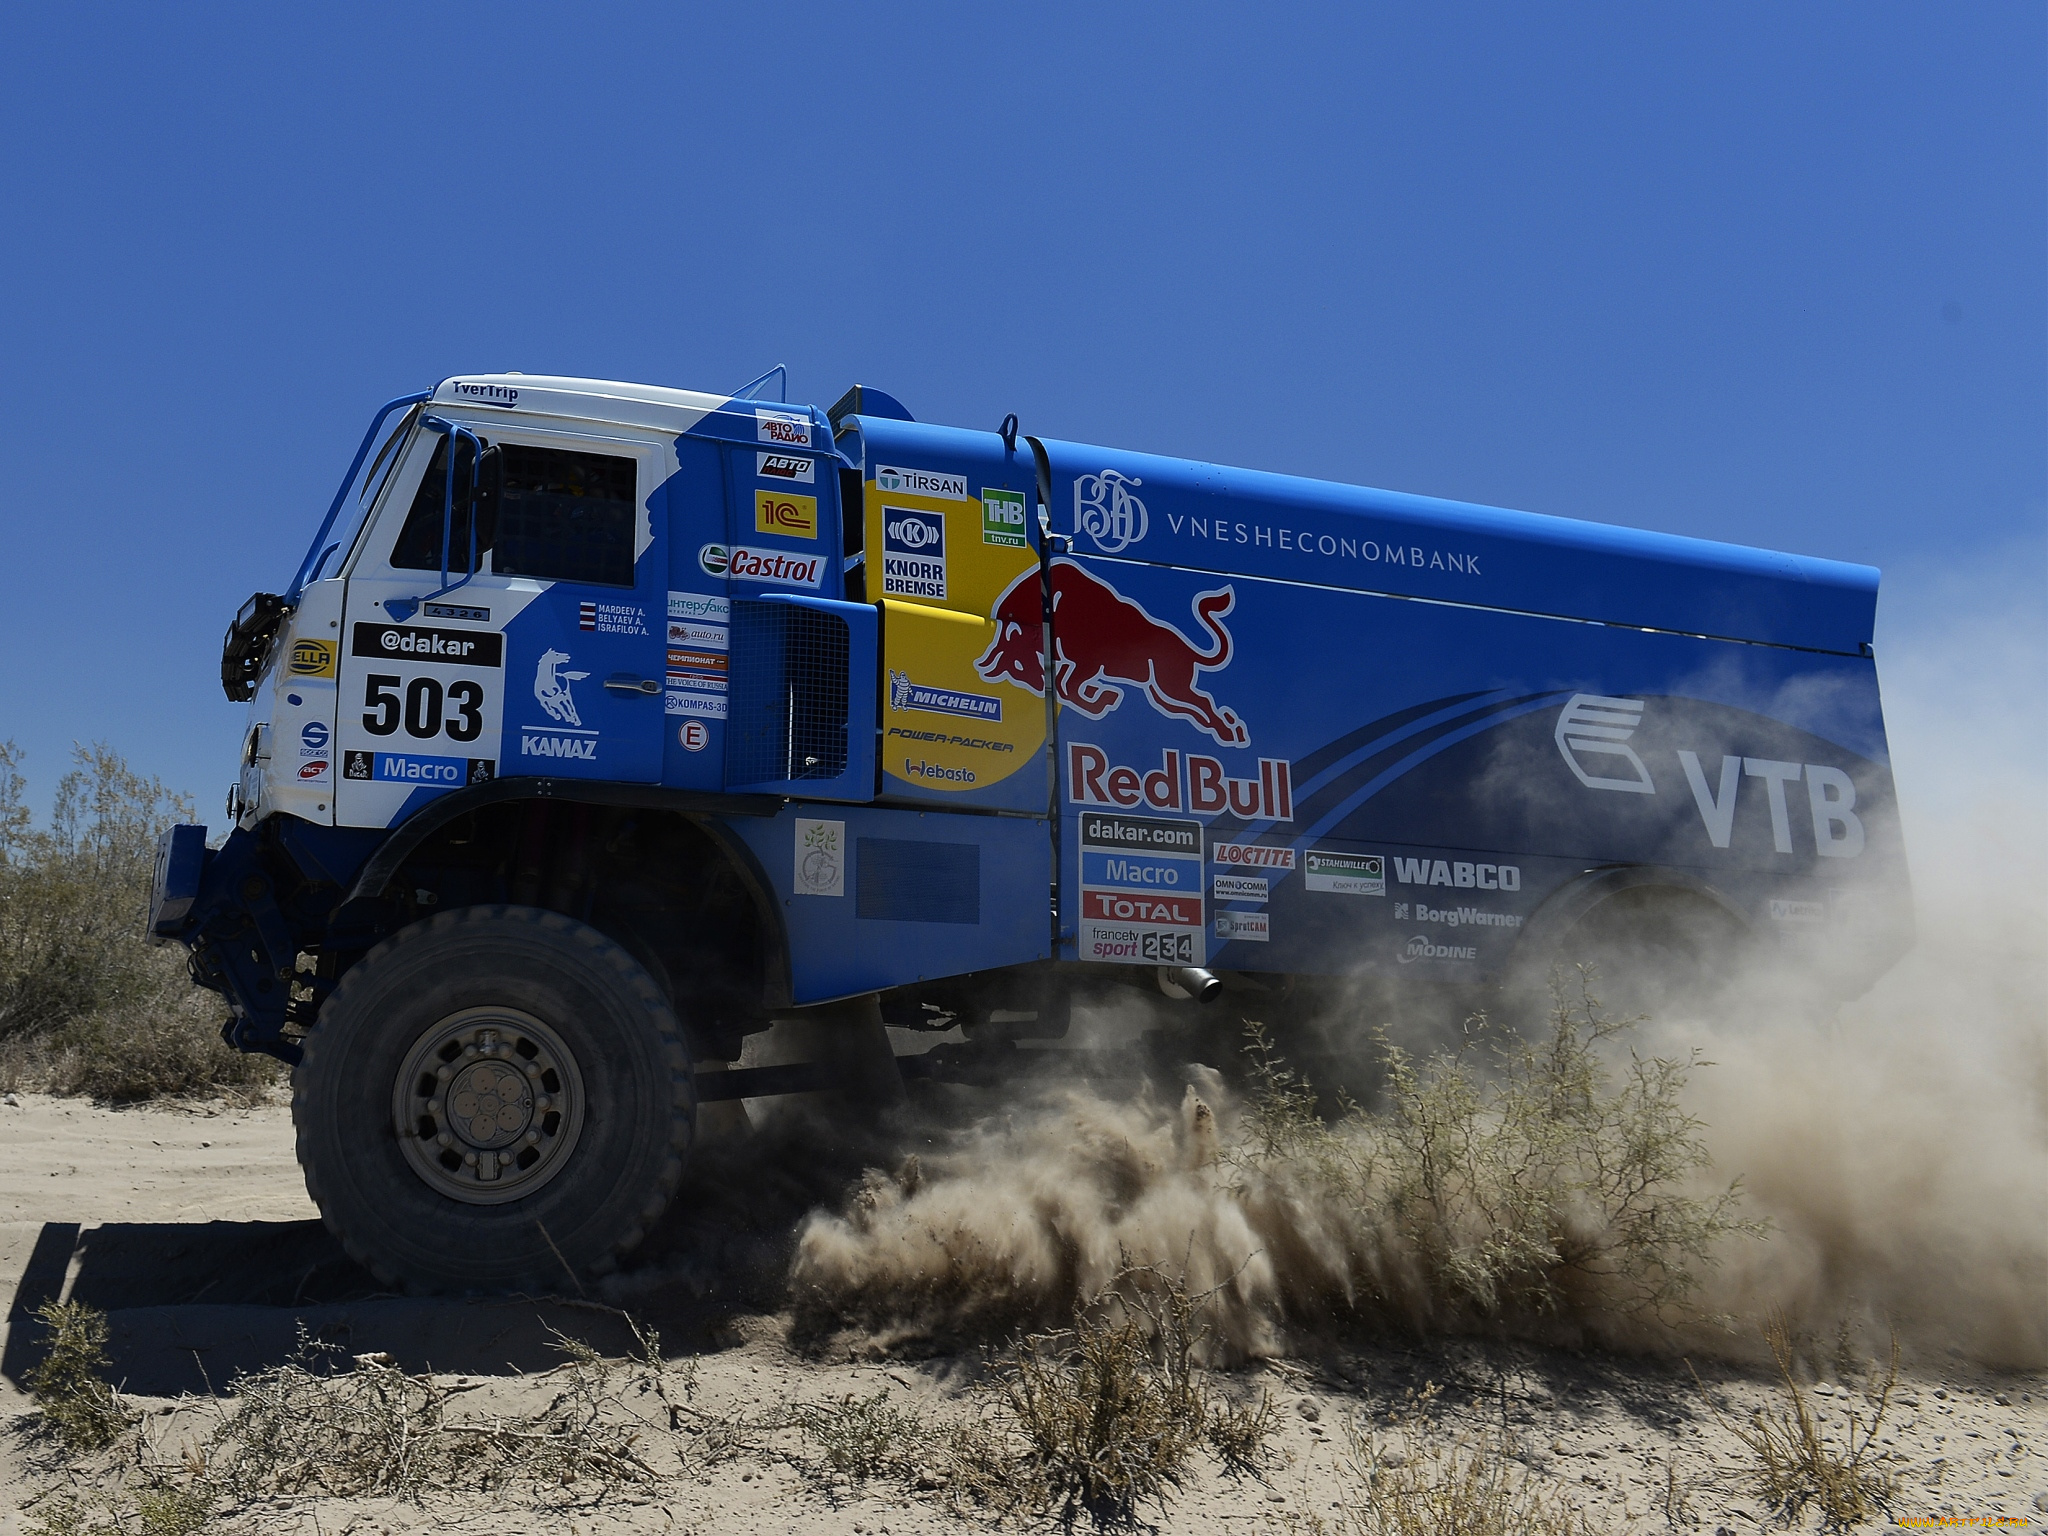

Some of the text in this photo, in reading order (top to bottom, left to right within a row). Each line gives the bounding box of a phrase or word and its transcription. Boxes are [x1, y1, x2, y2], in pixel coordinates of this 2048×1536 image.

[453, 381, 518, 401] TverTrip
[766, 457, 809, 471] АВТО
[991, 535, 1019, 545] tnv.ru
[1167, 513, 1482, 576] VNESHECONOMBANK
[730, 550, 817, 582] Castrol
[885, 558, 944, 581] KNORR
[885, 578, 945, 597] BREMSE
[431, 607, 482, 619] 4326
[598, 604, 636, 615] MARDEEV
[598, 614, 634, 625] BELYAEV
[598, 623, 640, 635] ISRAFILOV
[690, 630, 724, 641] auto.ru
[380, 630, 475, 656] @dakar
[291, 651, 331, 665] ELLA
[362, 673, 485, 742] 503
[678, 698, 728, 713] KOMPAS-3D
[913, 691, 998, 714] MICHELIN
[686, 725, 701, 746] E
[887, 727, 1015, 753] POWER-PACKER
[521, 735, 597, 760] KAMAZ
[383, 757, 458, 781] Macro
[904, 757, 976, 784] Webasto
[1068, 742, 1294, 822] Red Bull
[1677, 750, 1865, 859] VTB
[1088, 820, 1194, 846] dakar.com
[1216, 845, 1293, 867] LOCTITE
[1321, 857, 1367, 870] STAHLWILLE
[1106, 859, 1178, 885] Macro
[1393, 856, 1521, 892] WABCO
[1096, 894, 1189, 922] TOTAL
[1416, 904, 1523, 927] BorgWarner
[1093, 927, 1139, 942] francetv
[1093, 941, 1138, 958] sport
[1406, 944, 1477, 959] MODINE
